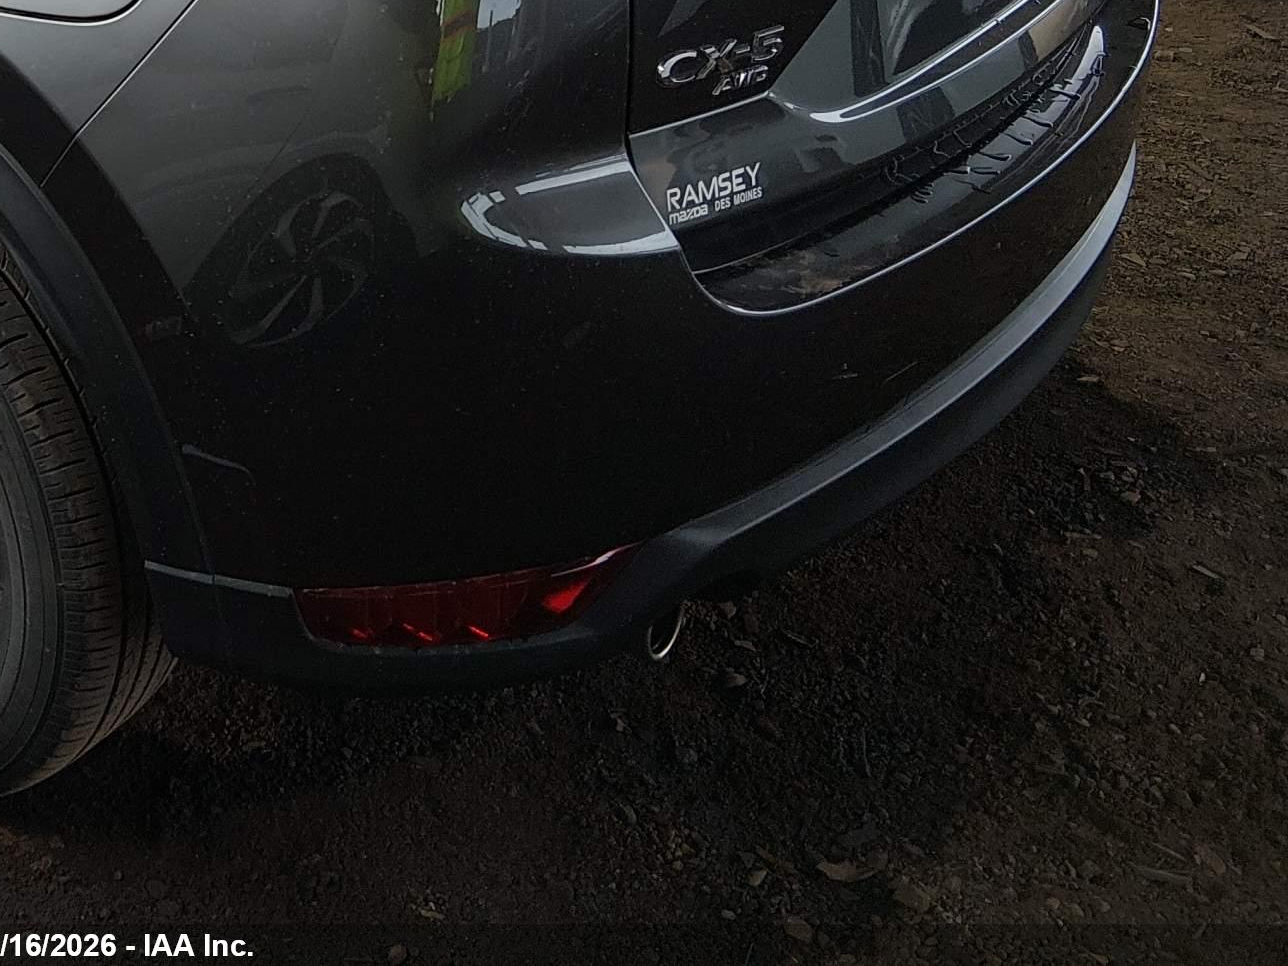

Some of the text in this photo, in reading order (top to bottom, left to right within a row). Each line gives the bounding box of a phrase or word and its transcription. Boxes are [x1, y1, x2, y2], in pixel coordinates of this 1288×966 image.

[656, 24, 784, 86] CX-5
[666, 161, 761, 212] RAMSEY
[714, 197, 731, 212] DES
[733, 186, 763, 206] MOINES
